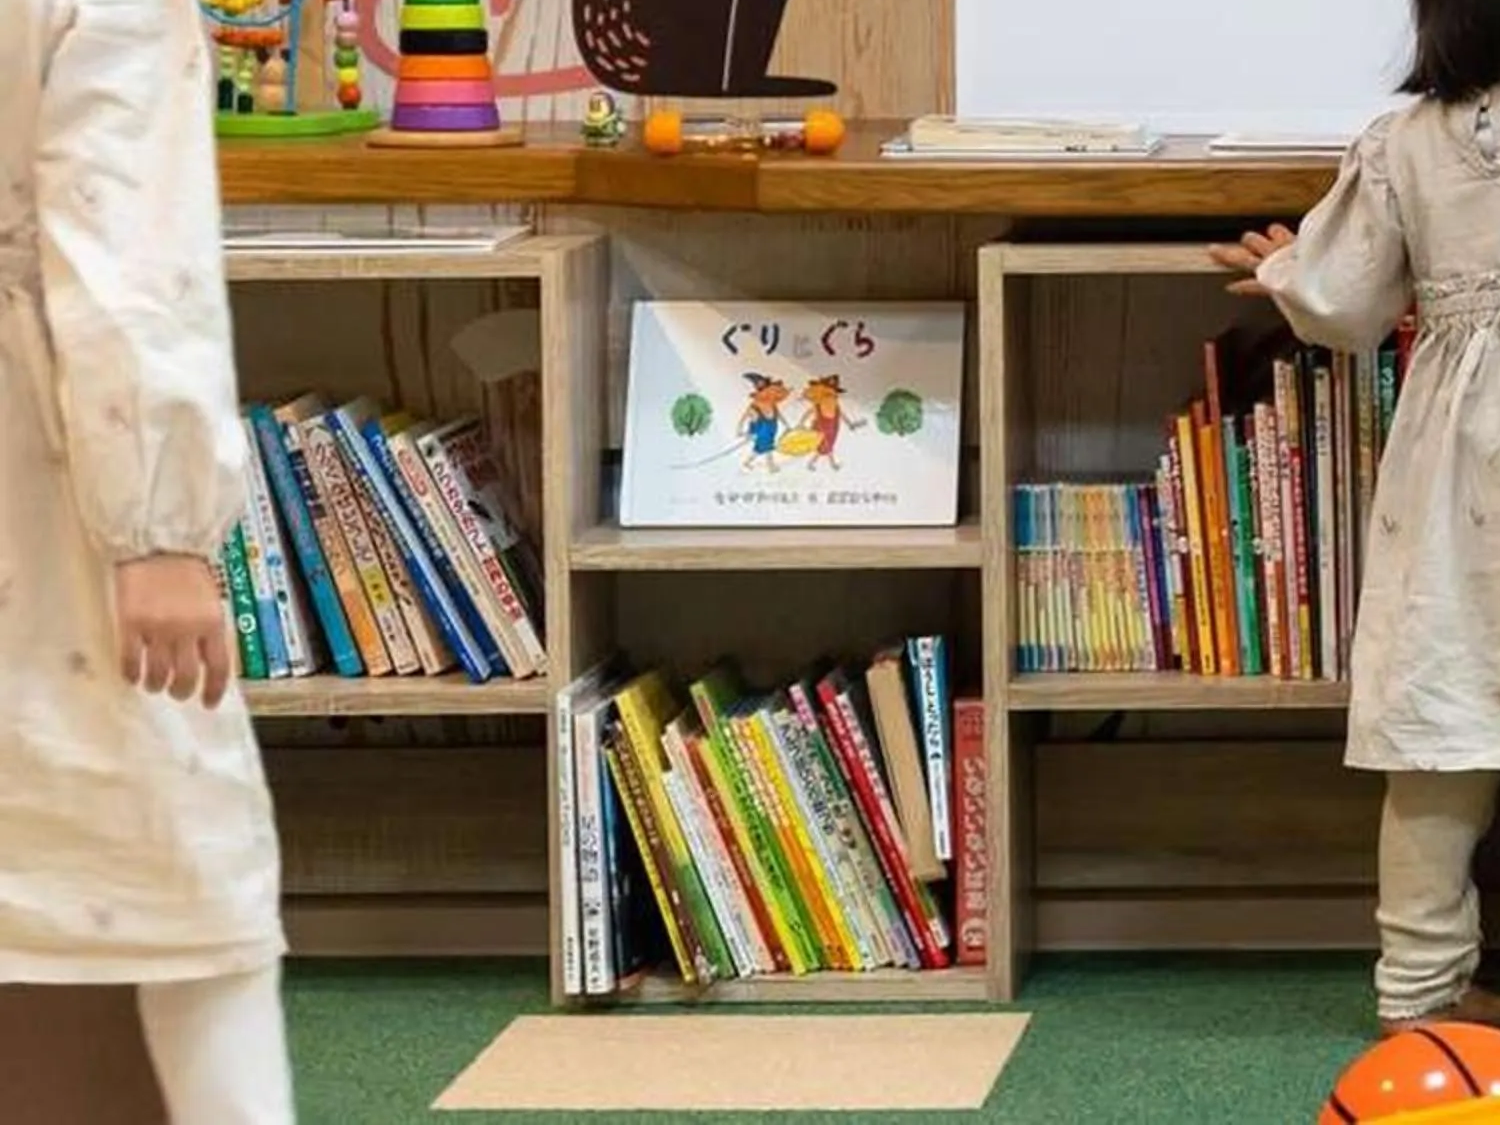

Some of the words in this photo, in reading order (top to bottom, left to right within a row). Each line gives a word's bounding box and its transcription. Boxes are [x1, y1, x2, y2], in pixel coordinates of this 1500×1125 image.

[721, 321, 875, 358] ぐりとぐら
